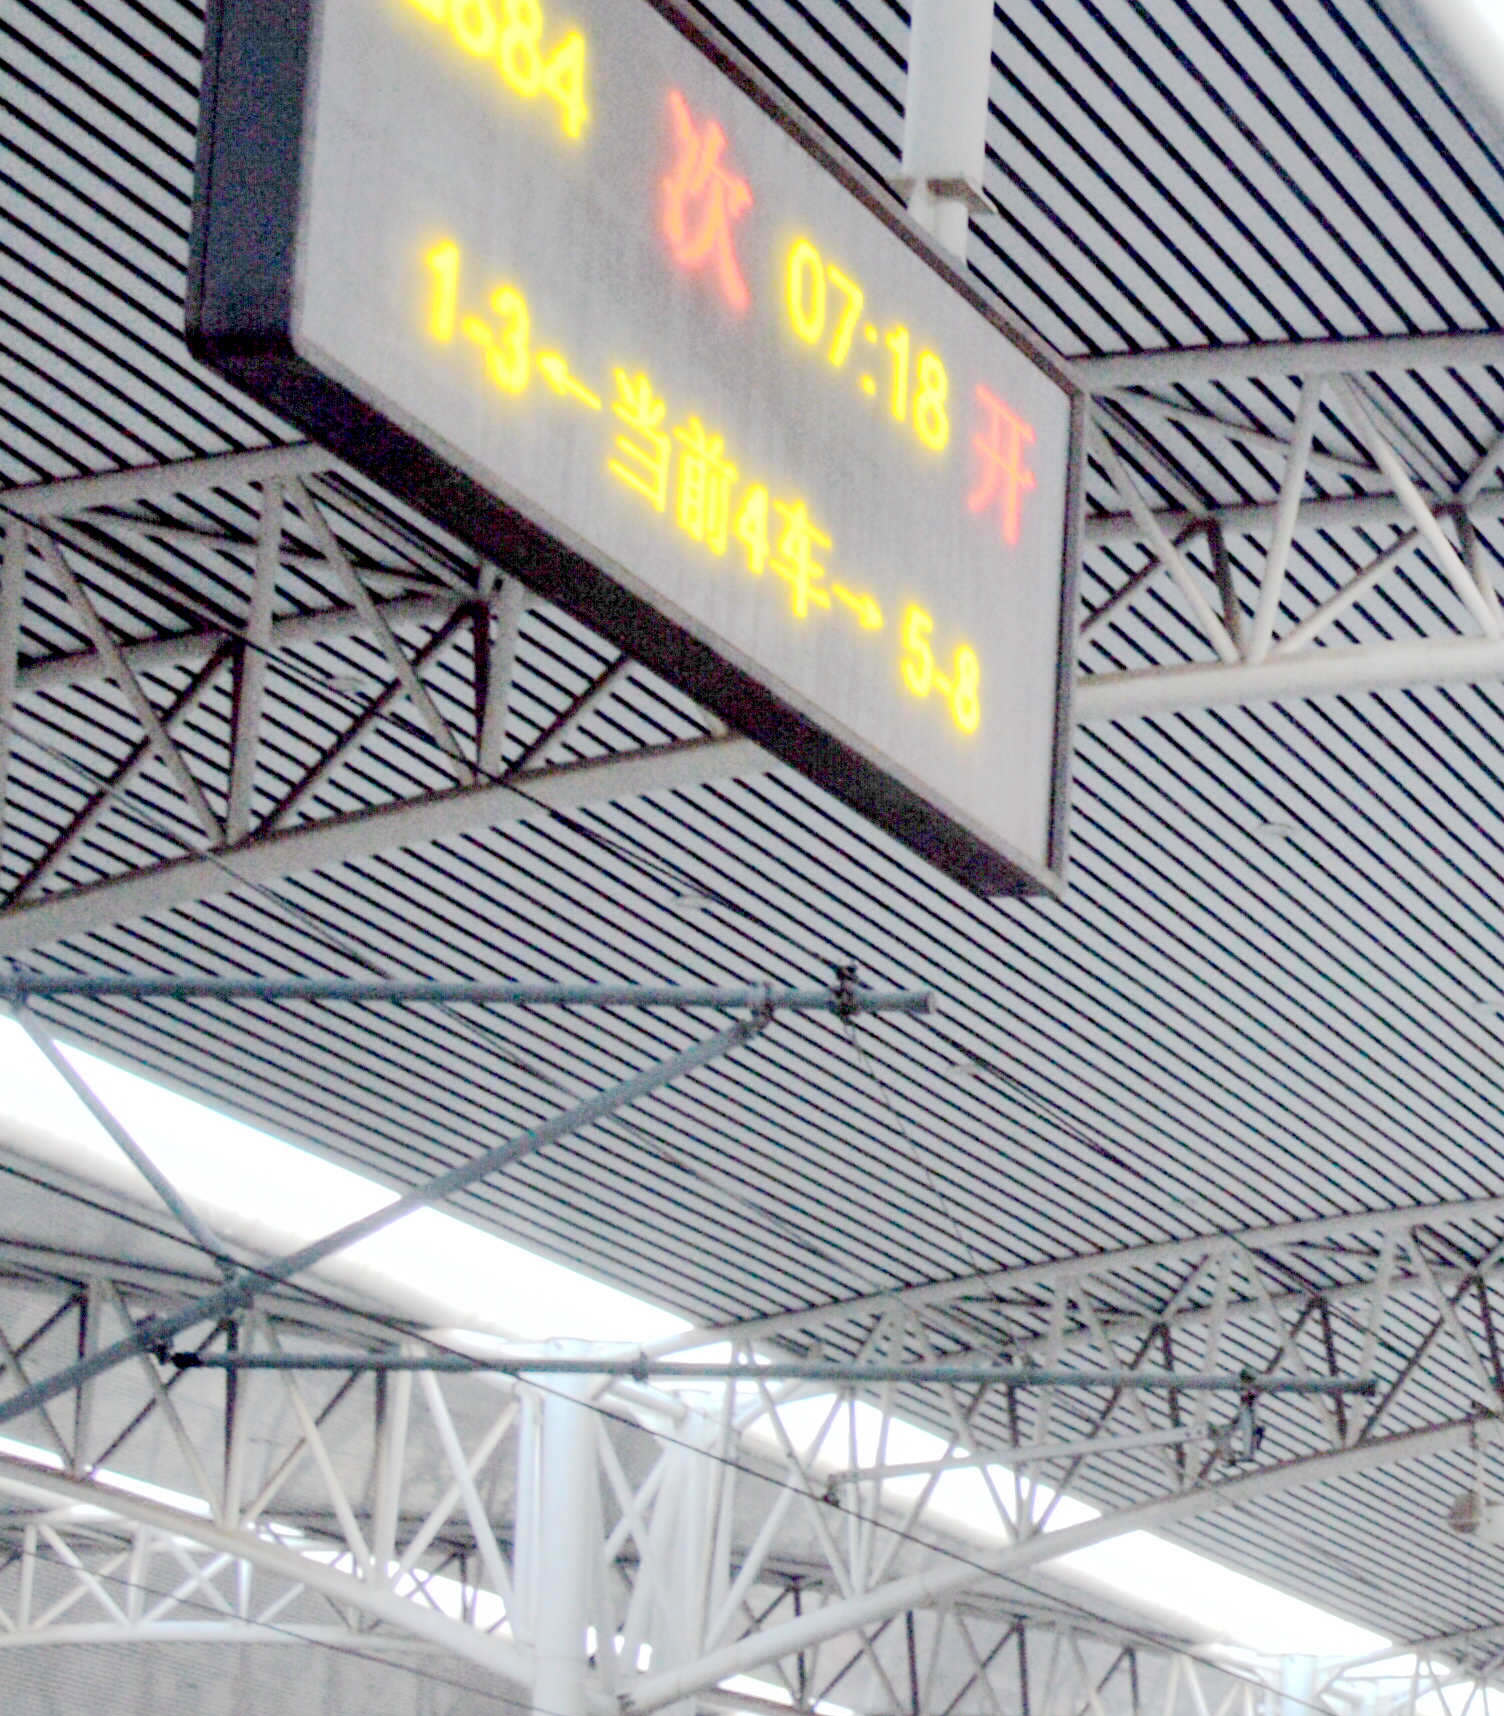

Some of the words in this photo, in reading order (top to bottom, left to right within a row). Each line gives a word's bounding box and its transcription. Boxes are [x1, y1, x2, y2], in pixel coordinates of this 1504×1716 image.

[661, 88, 755, 313] 次
[782, 234, 950, 453] 07:18
[967, 382, 1038, 546] 开
[899, 602, 984, 735] 5-8
